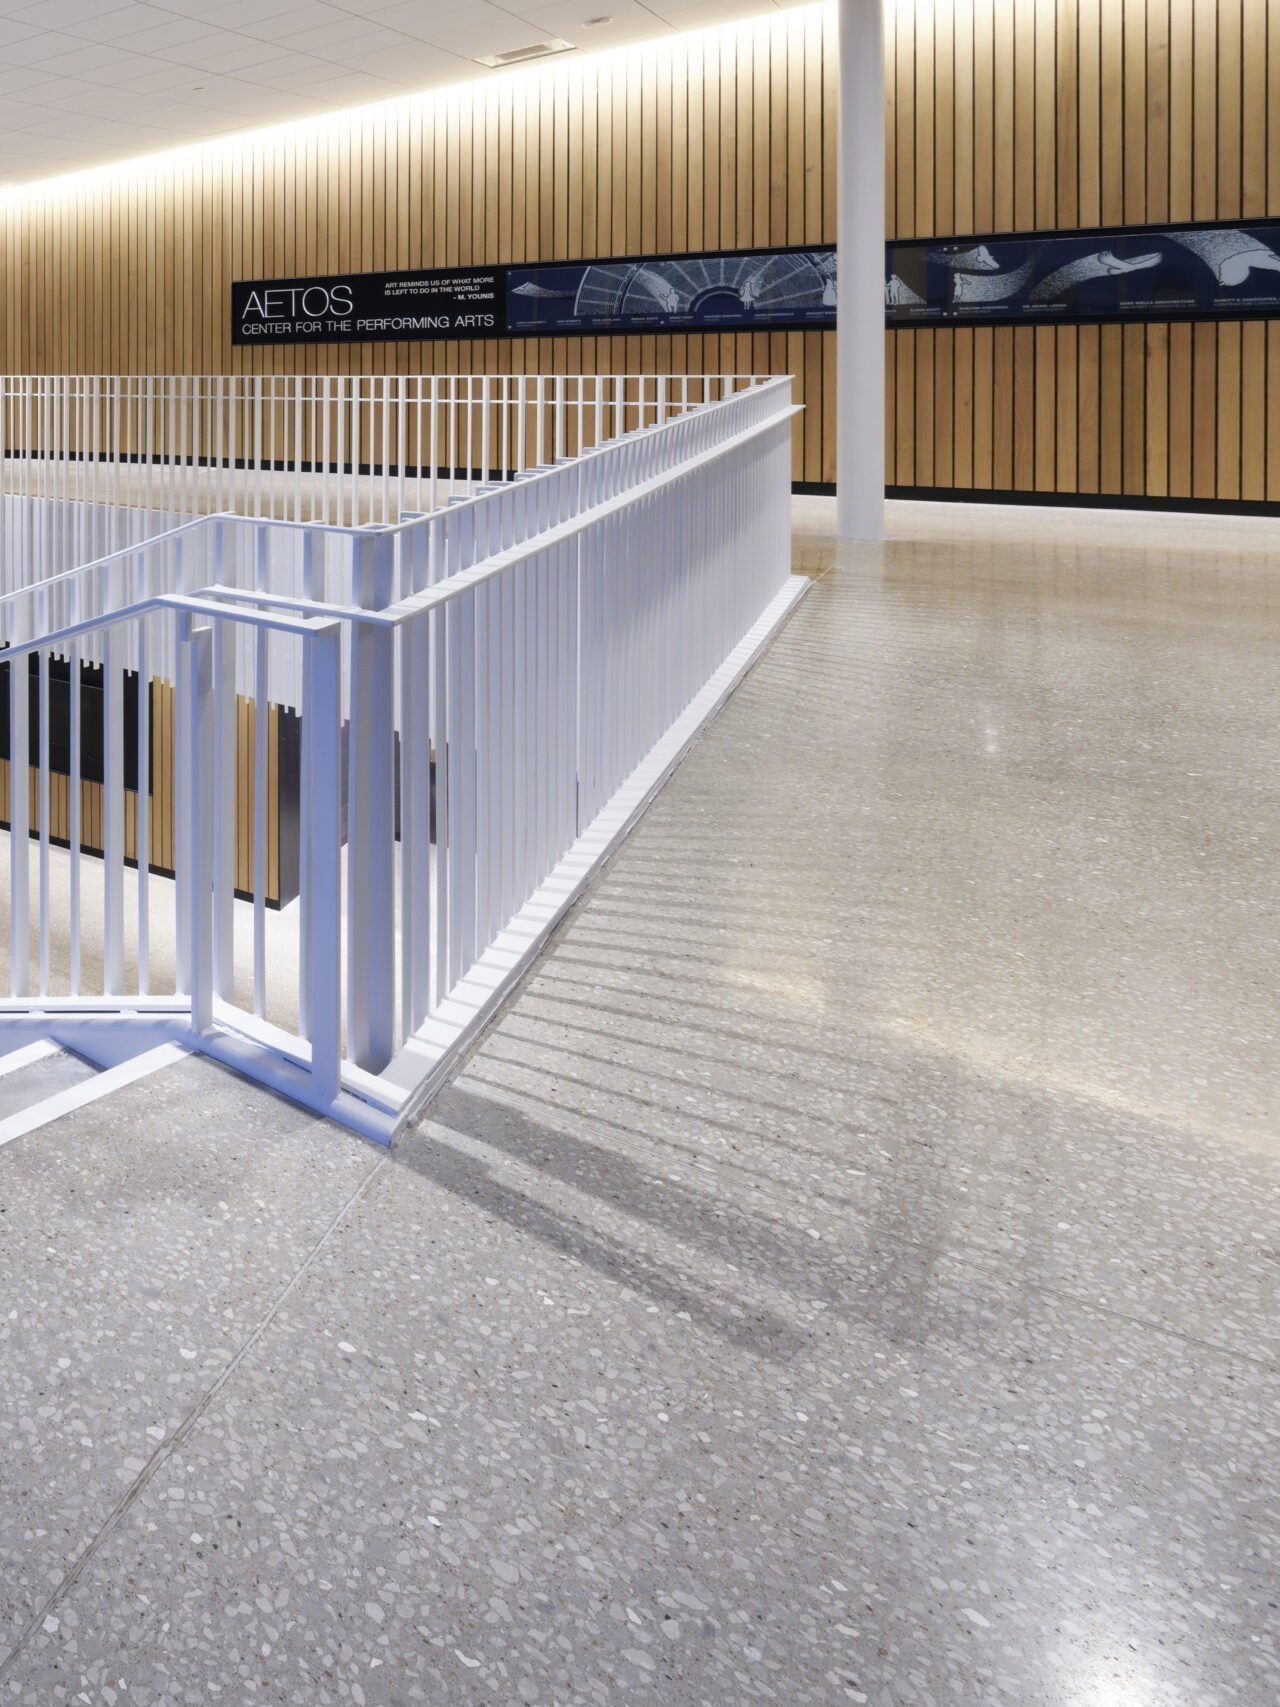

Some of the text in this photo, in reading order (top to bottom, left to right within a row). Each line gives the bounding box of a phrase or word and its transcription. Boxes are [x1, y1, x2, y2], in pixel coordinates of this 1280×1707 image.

[242, 285, 354, 319] AETOS
[242, 314, 494, 335] CENTER FOR THE PERFORMING ARTS
